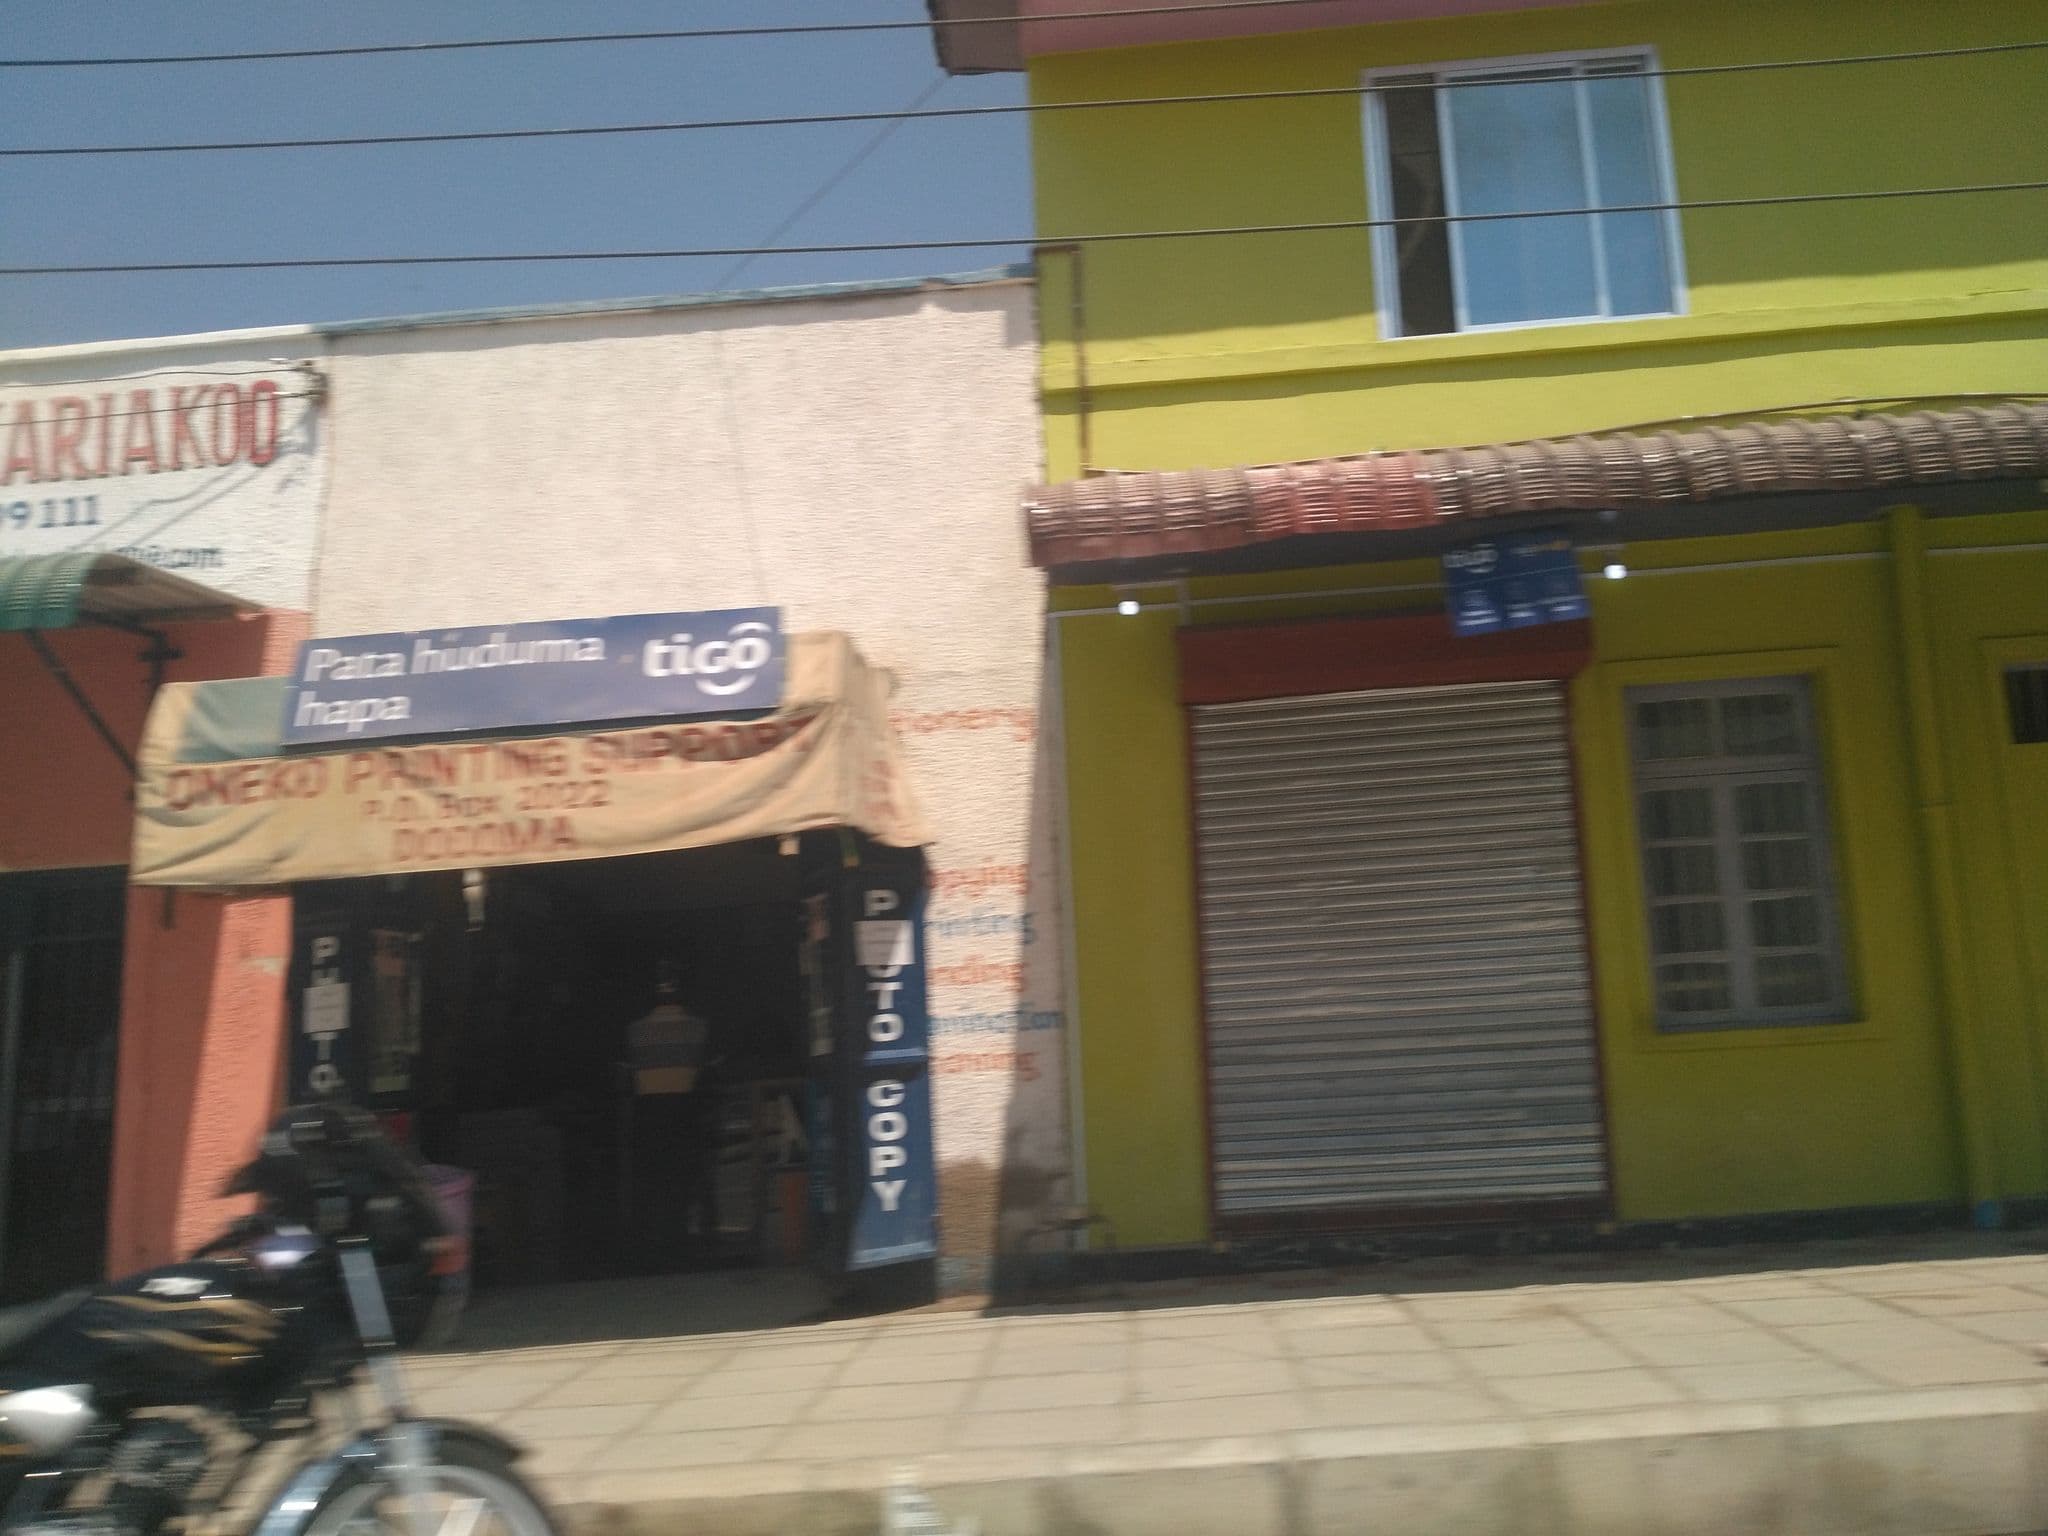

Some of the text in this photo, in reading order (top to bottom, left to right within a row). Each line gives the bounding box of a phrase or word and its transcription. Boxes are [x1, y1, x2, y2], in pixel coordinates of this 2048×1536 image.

[0, 378, 279, 486] ARIAKOO
[643, 621, 772, 696] tigo
[294, 691, 410, 733] hapa
[866, 1079, 908, 1212] COPY
